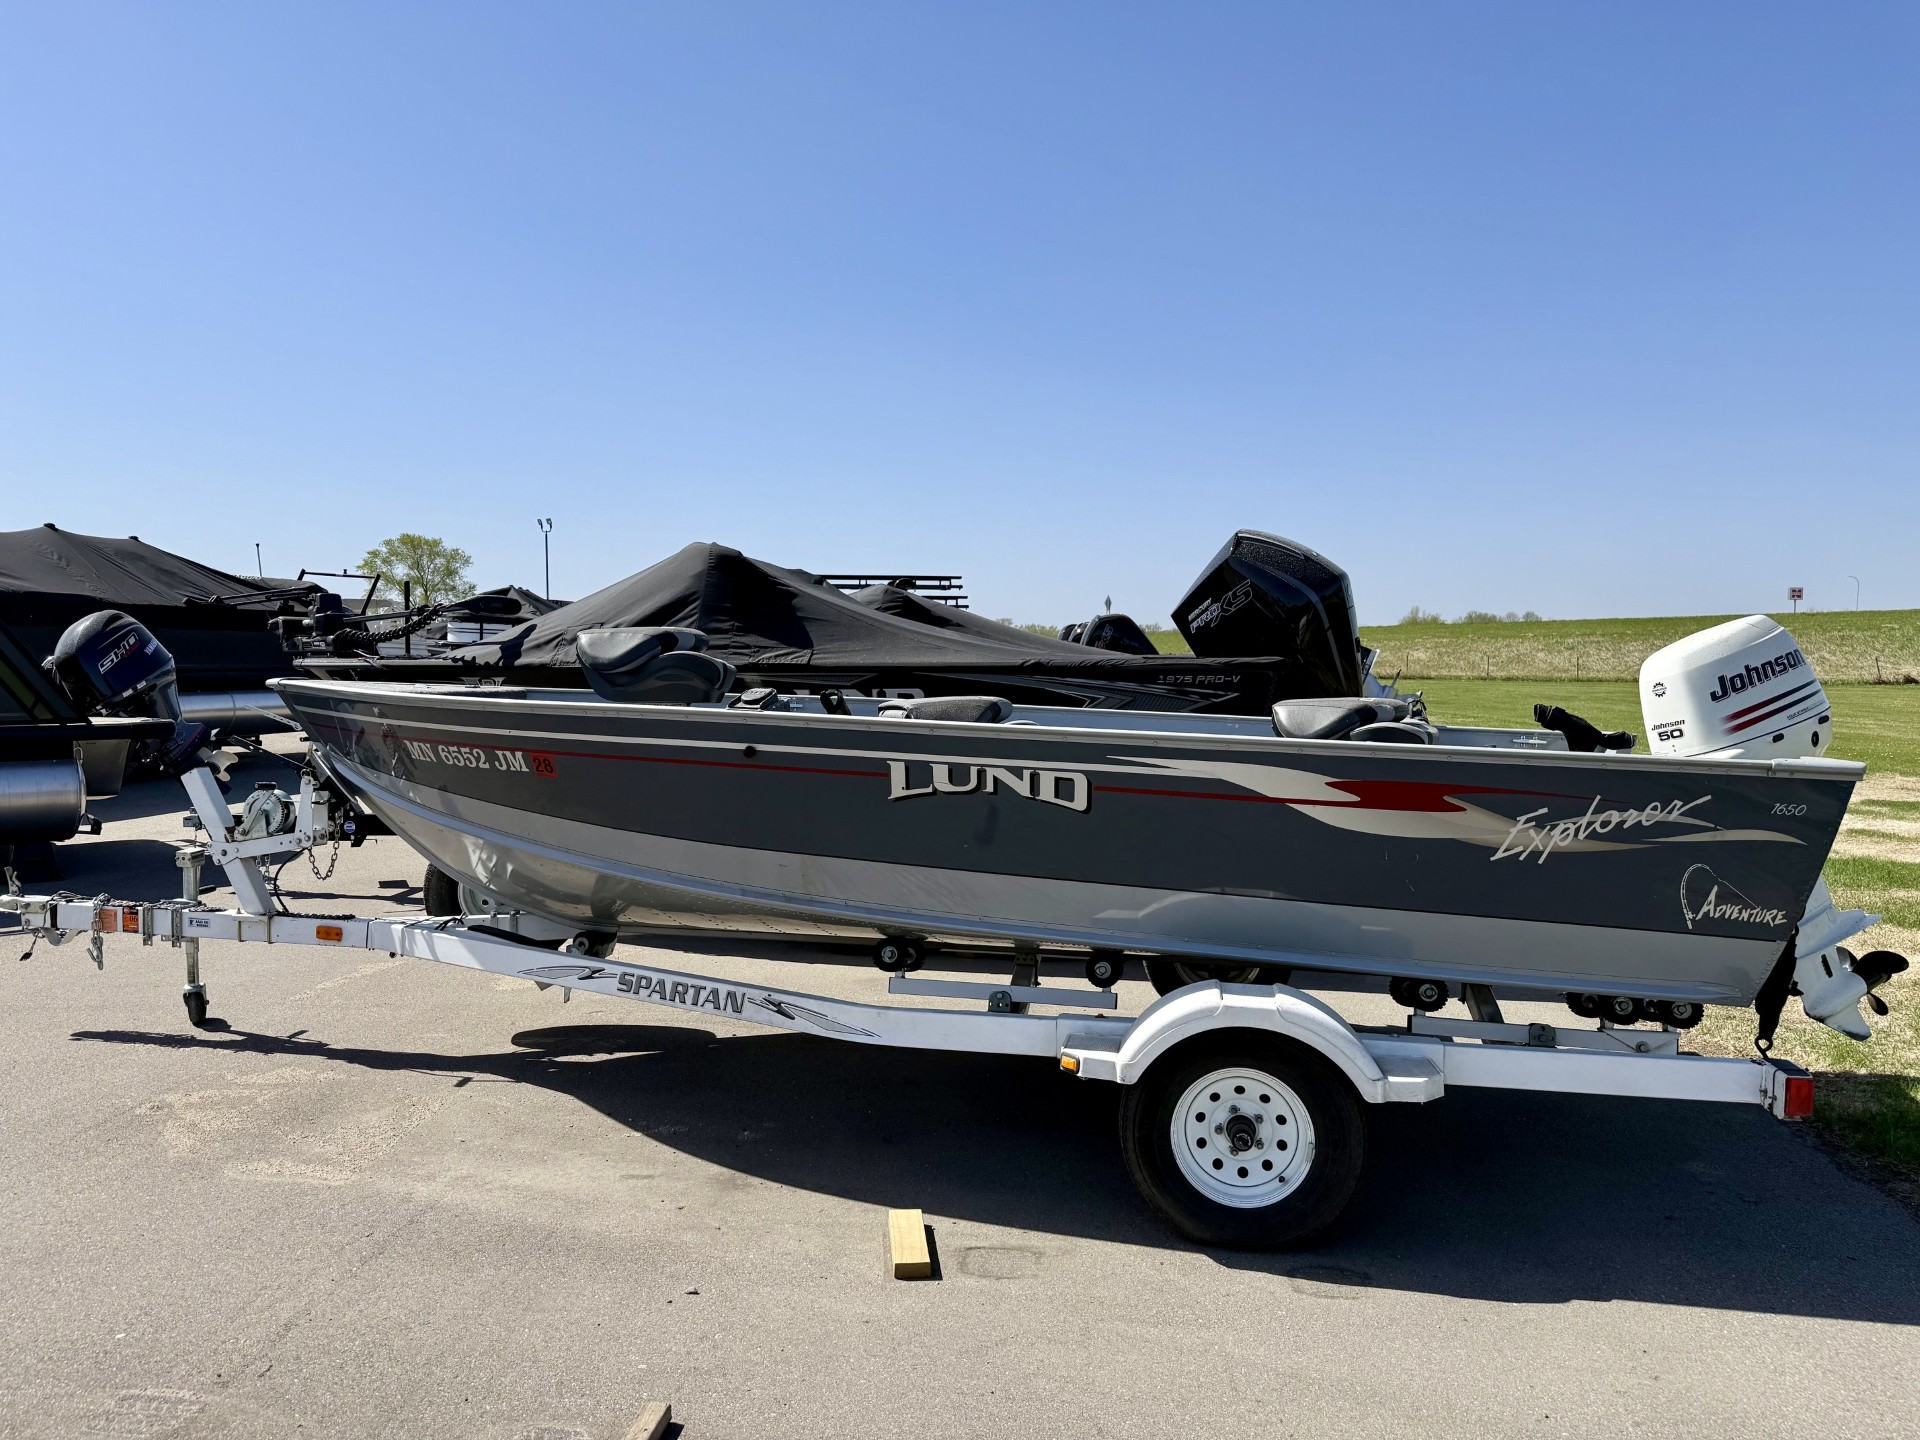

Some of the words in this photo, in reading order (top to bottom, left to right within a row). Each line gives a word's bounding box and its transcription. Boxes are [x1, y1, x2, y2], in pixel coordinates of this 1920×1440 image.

[1157, 675, 1193, 683] 1975
[1195, 675, 1240, 684] PRO-V
[1710, 649, 1806, 703] Johnson
[1652, 719, 1685, 731] Johnson
[1657, 728, 1684, 741] 50
[404, 740, 437, 762] MN
[438, 745, 490, 769] 6552
[495, 750, 530, 772] JM
[533, 757, 554, 774] 28
[887, 761, 1092, 814] LUND
[1771, 803, 1807, 816] 1650
[1490, 795, 1711, 864] Explorer
[1696, 885, 1788, 926] ADVENTURE
[617, 972, 746, 1013] SPARTAN
